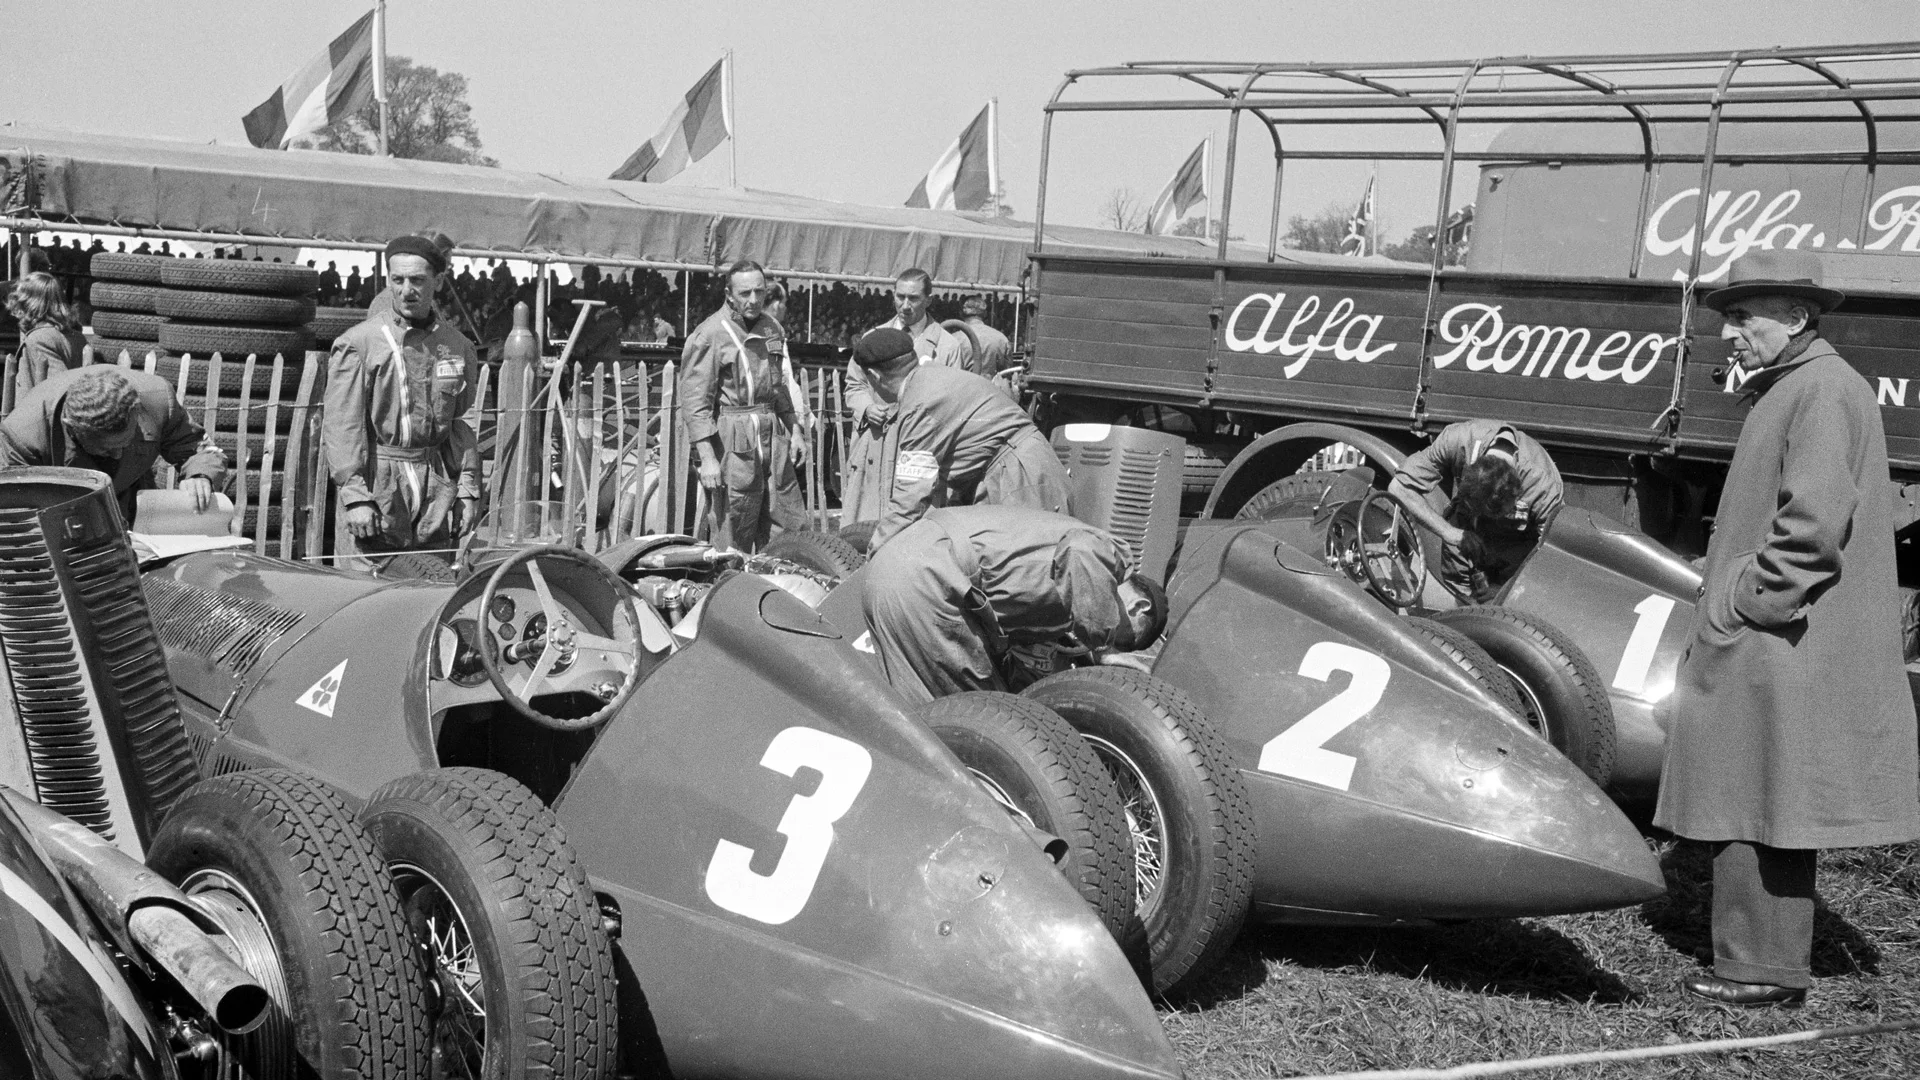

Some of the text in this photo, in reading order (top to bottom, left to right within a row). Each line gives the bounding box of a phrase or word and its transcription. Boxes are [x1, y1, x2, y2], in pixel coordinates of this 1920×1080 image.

[251, 186, 279, 226] 4
[1225, 293, 1397, 379] Alfa
[1433, 303, 1680, 384] Romeo
[1611, 594, 1676, 695] 1
[1258, 642, 1392, 790] 2
[705, 727, 873, 925] 3
